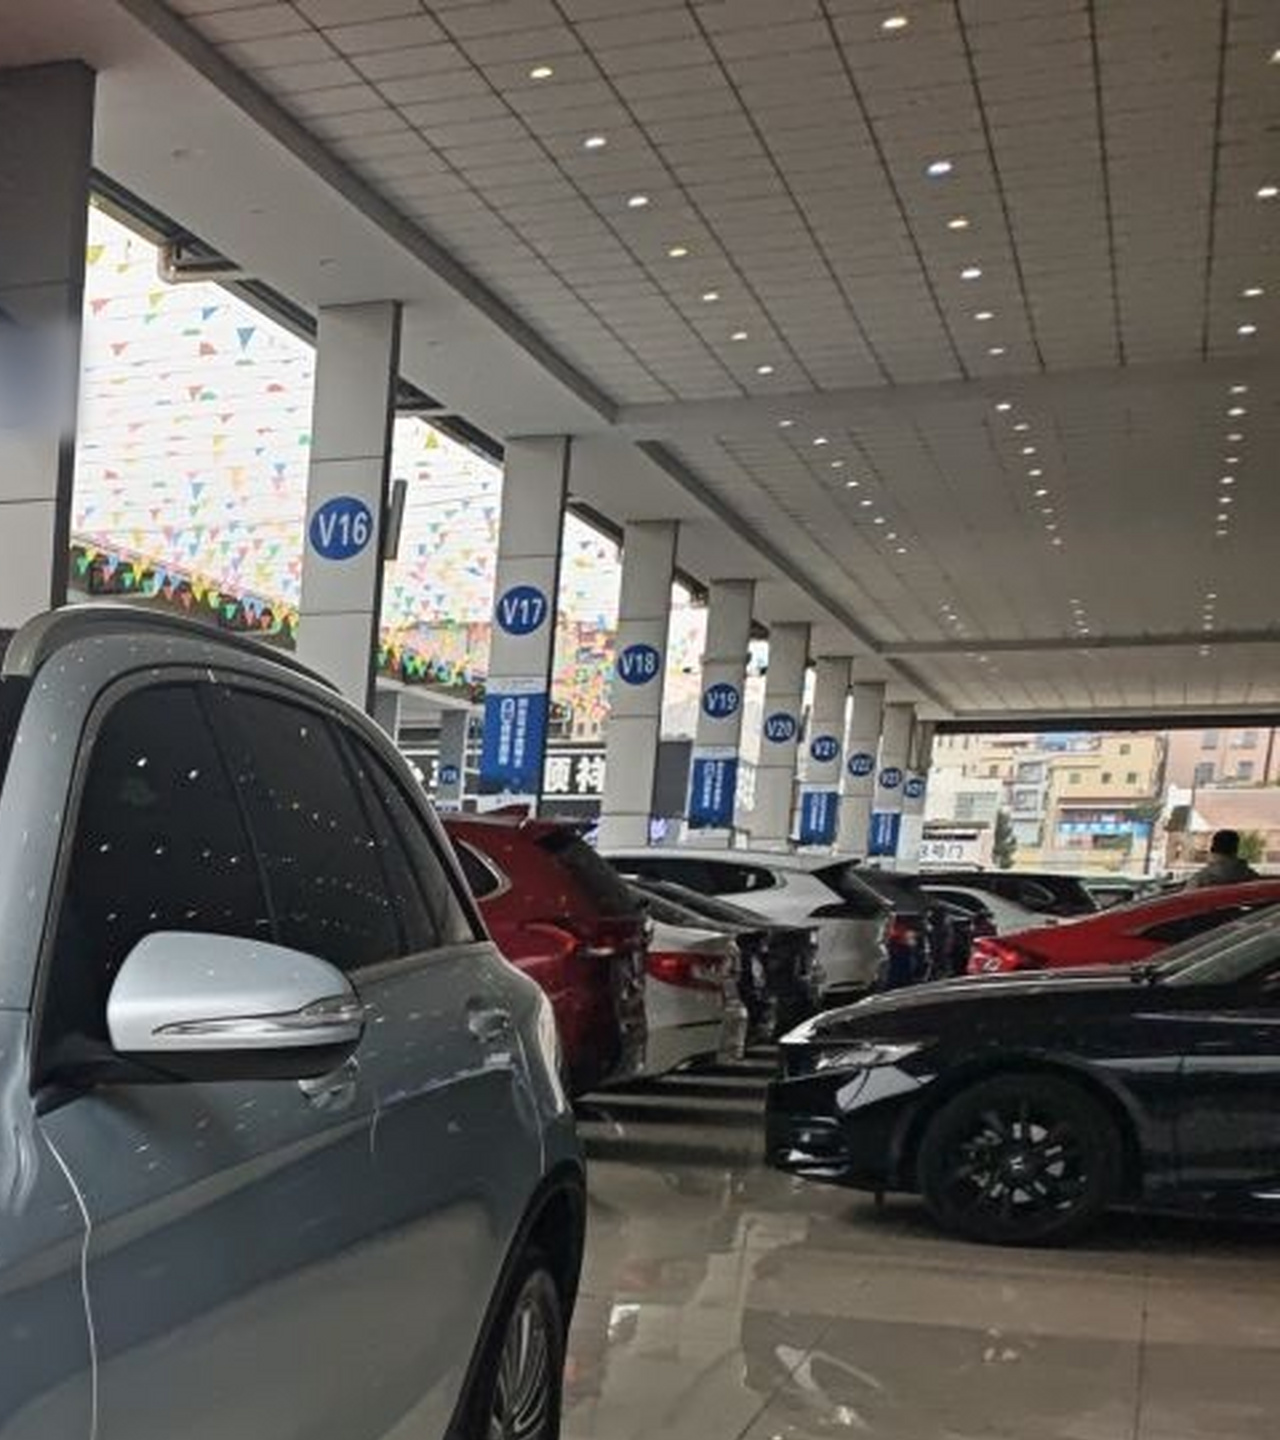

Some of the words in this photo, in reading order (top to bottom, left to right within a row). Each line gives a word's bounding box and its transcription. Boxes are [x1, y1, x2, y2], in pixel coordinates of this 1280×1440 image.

[318, 510, 369, 548] V16
[503, 597, 543, 626] V17
[621, 651, 656, 677] V18
[707, 690, 738, 711] V19
